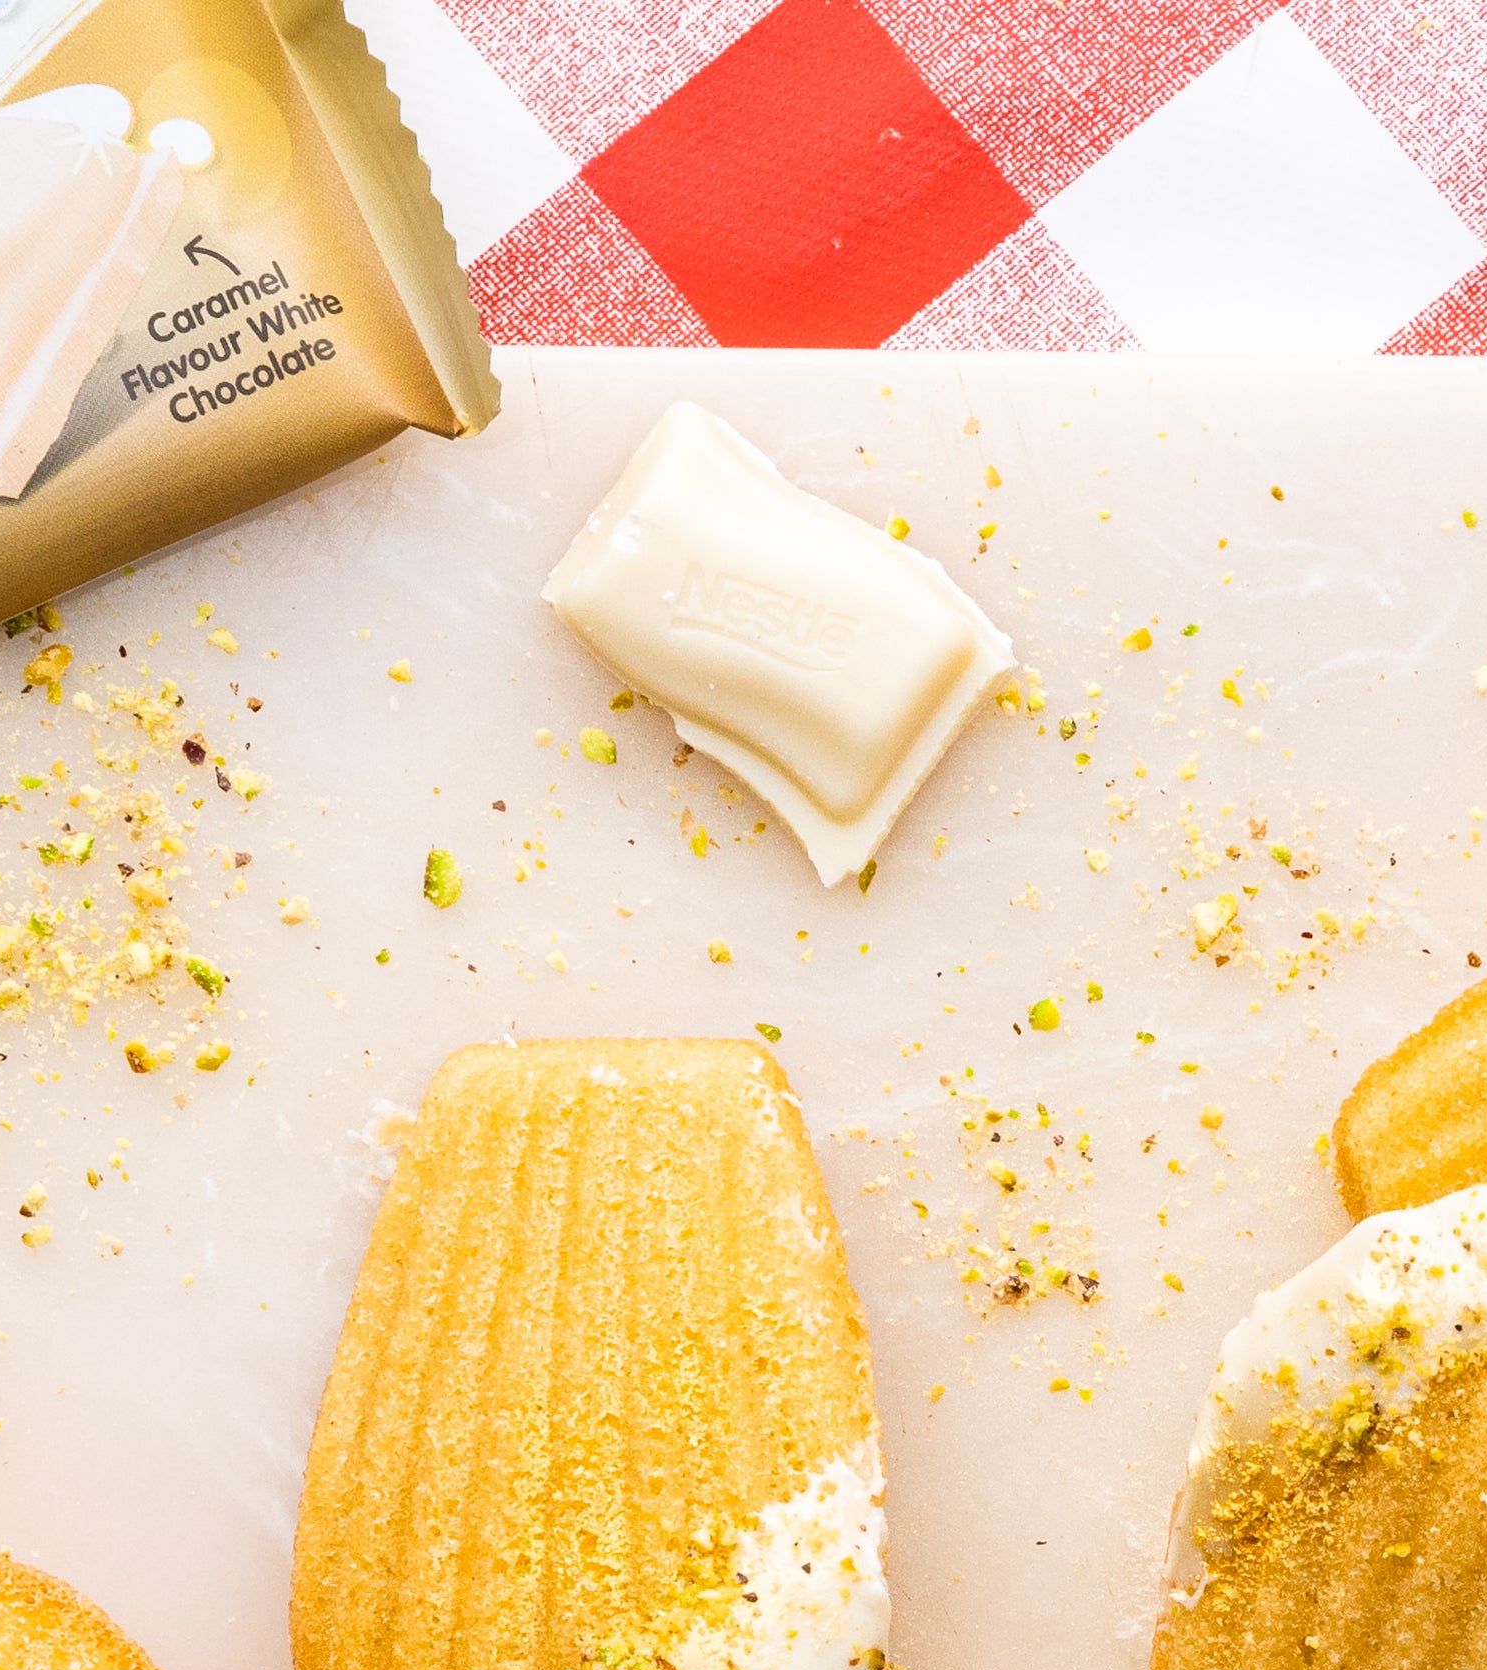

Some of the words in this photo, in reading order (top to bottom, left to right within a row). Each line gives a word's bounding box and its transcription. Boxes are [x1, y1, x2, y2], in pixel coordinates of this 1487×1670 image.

[148, 261, 289, 342] Caramel
[121, 331, 241, 400] Flavour
[246, 293, 343, 343] White
[170, 338, 336, 423] Chocolate
